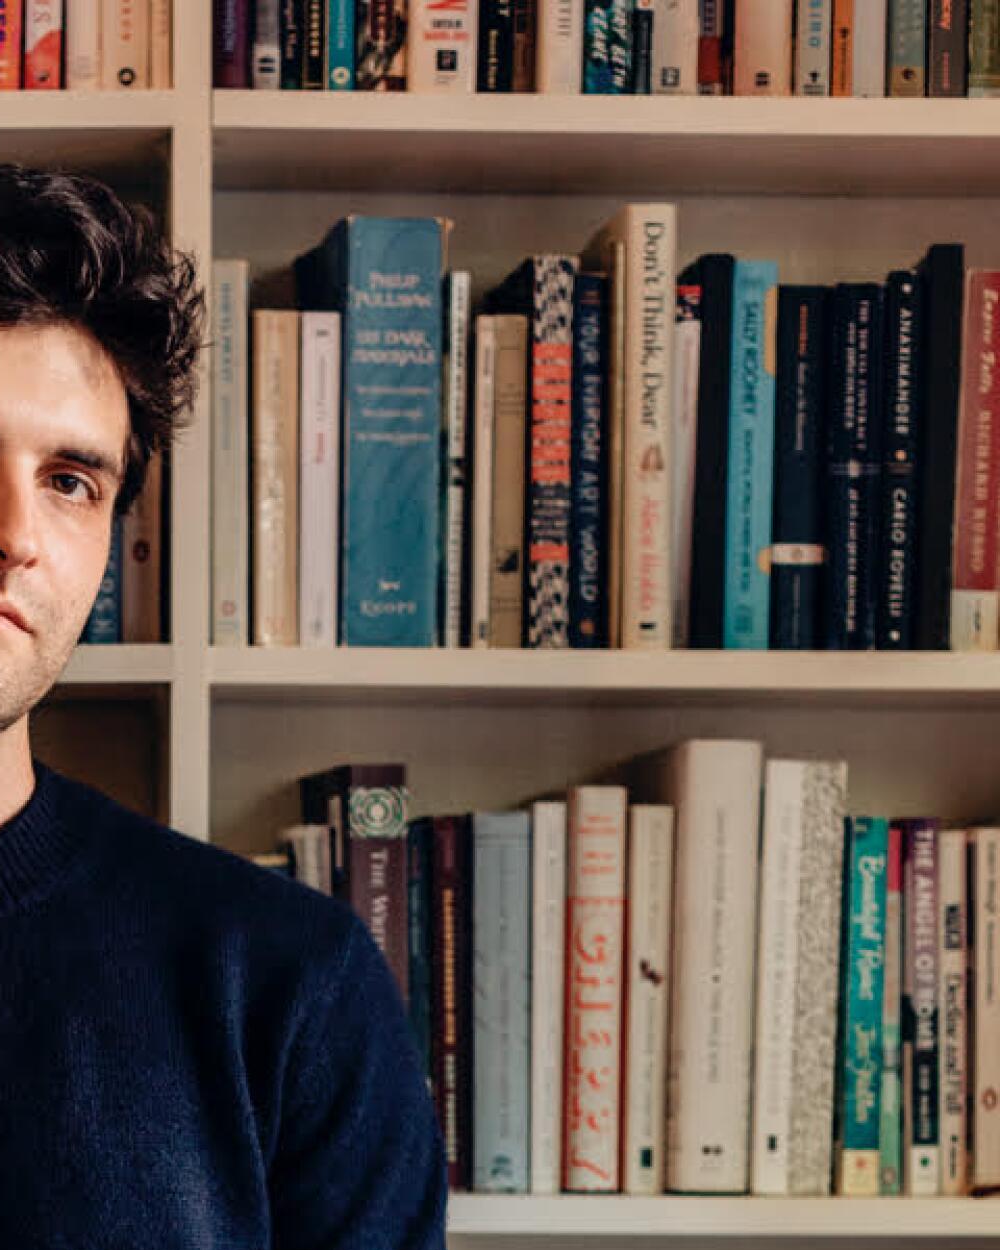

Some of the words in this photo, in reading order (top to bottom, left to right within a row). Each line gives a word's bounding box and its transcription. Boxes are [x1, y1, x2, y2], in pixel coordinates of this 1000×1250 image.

[642, 221, 667, 285] Don't
[639, 290, 666, 365] Think,
[641, 371, 665, 426] Dear
[913, 828, 934, 869] THE
[913, 873, 934, 950] ANGEL
[913, 952, 934, 982] OF
